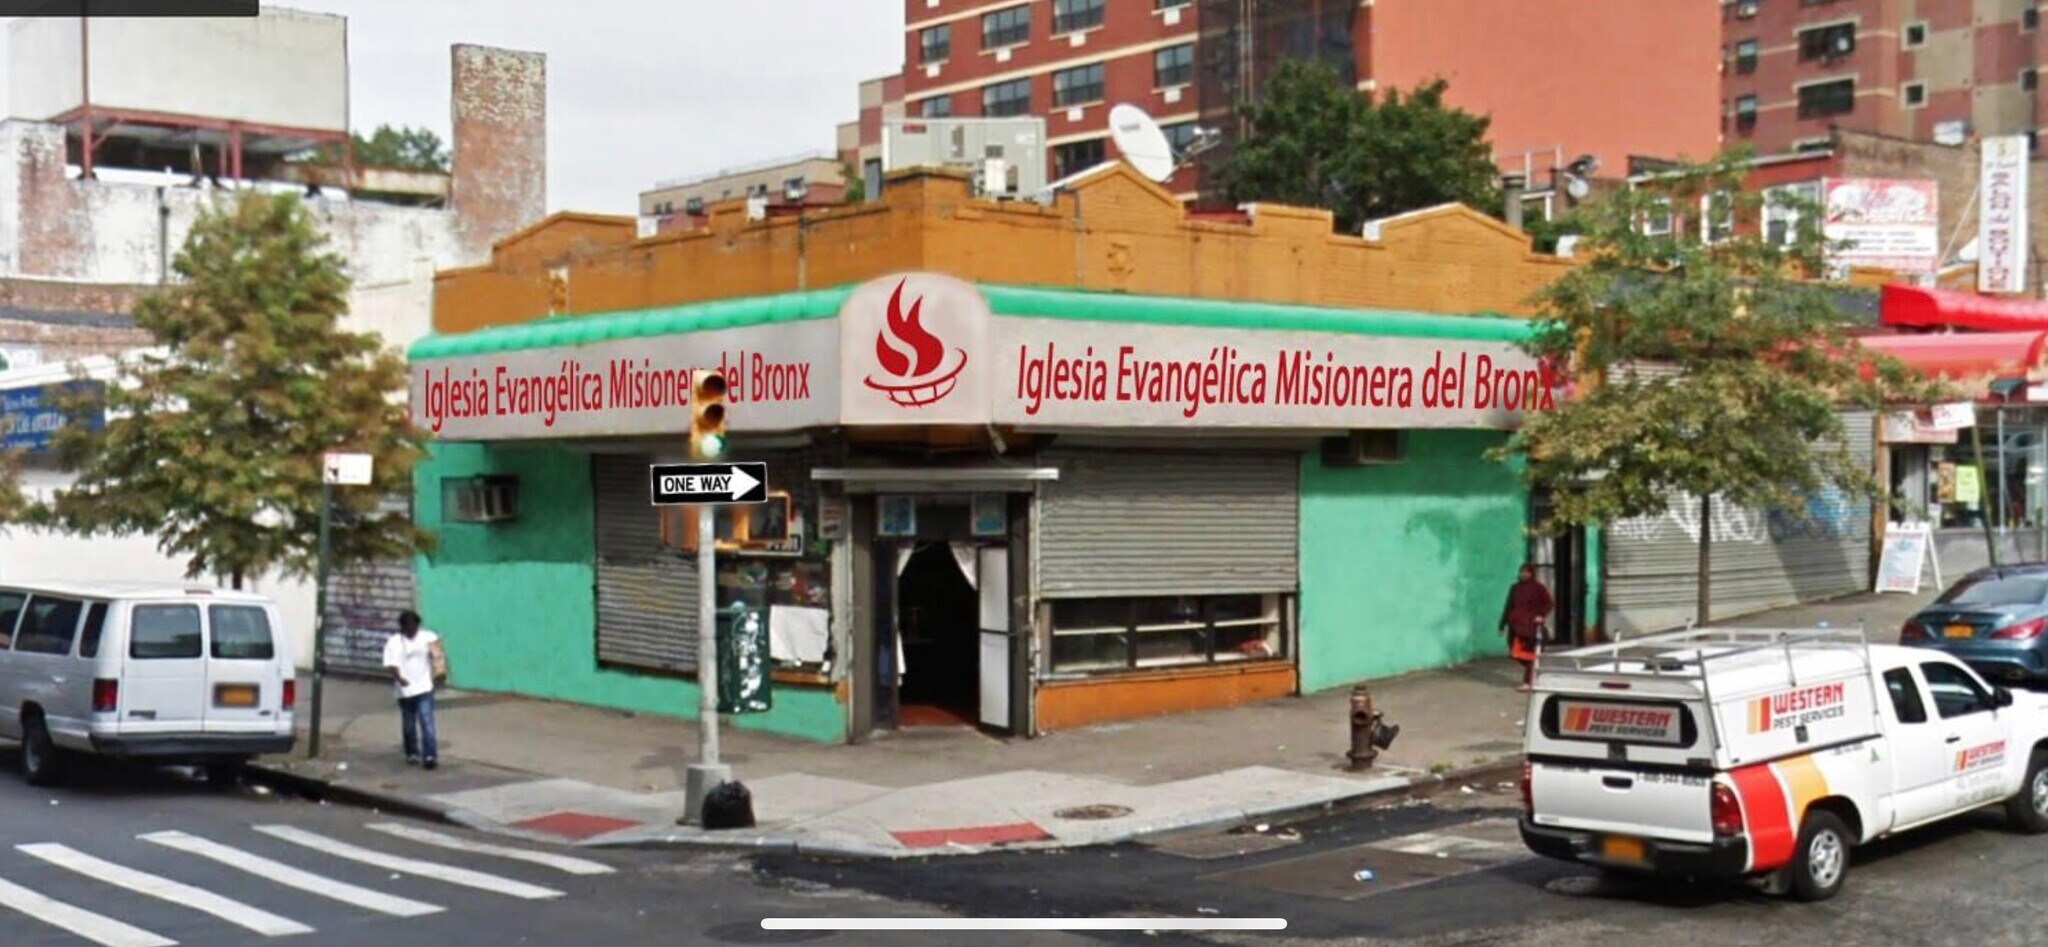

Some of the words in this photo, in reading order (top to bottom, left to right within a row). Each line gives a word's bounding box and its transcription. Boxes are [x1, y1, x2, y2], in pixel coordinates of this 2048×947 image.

[425, 366, 489, 432] Iglesia
[496, 360, 603, 426] Evangélica
[752, 352, 810, 402] Bronx
[1017, 341, 1107, 415] Iglesia
[1116, 346, 1267, 417] Evangélica
[1274, 350, 1413, 408] Misionera
[1421, 350, 1467, 408] del
[1474, 354, 1556, 410] Bronx
[664, 476, 695, 492] ONE
[700, 476, 732, 492] WAY
[1772, 682, 1845, 714] WESTERN
[1591, 708, 1673, 728] WESTERN
[1773, 715, 1797, 729] PEST
[1799, 705, 1845, 725] SERVICES
